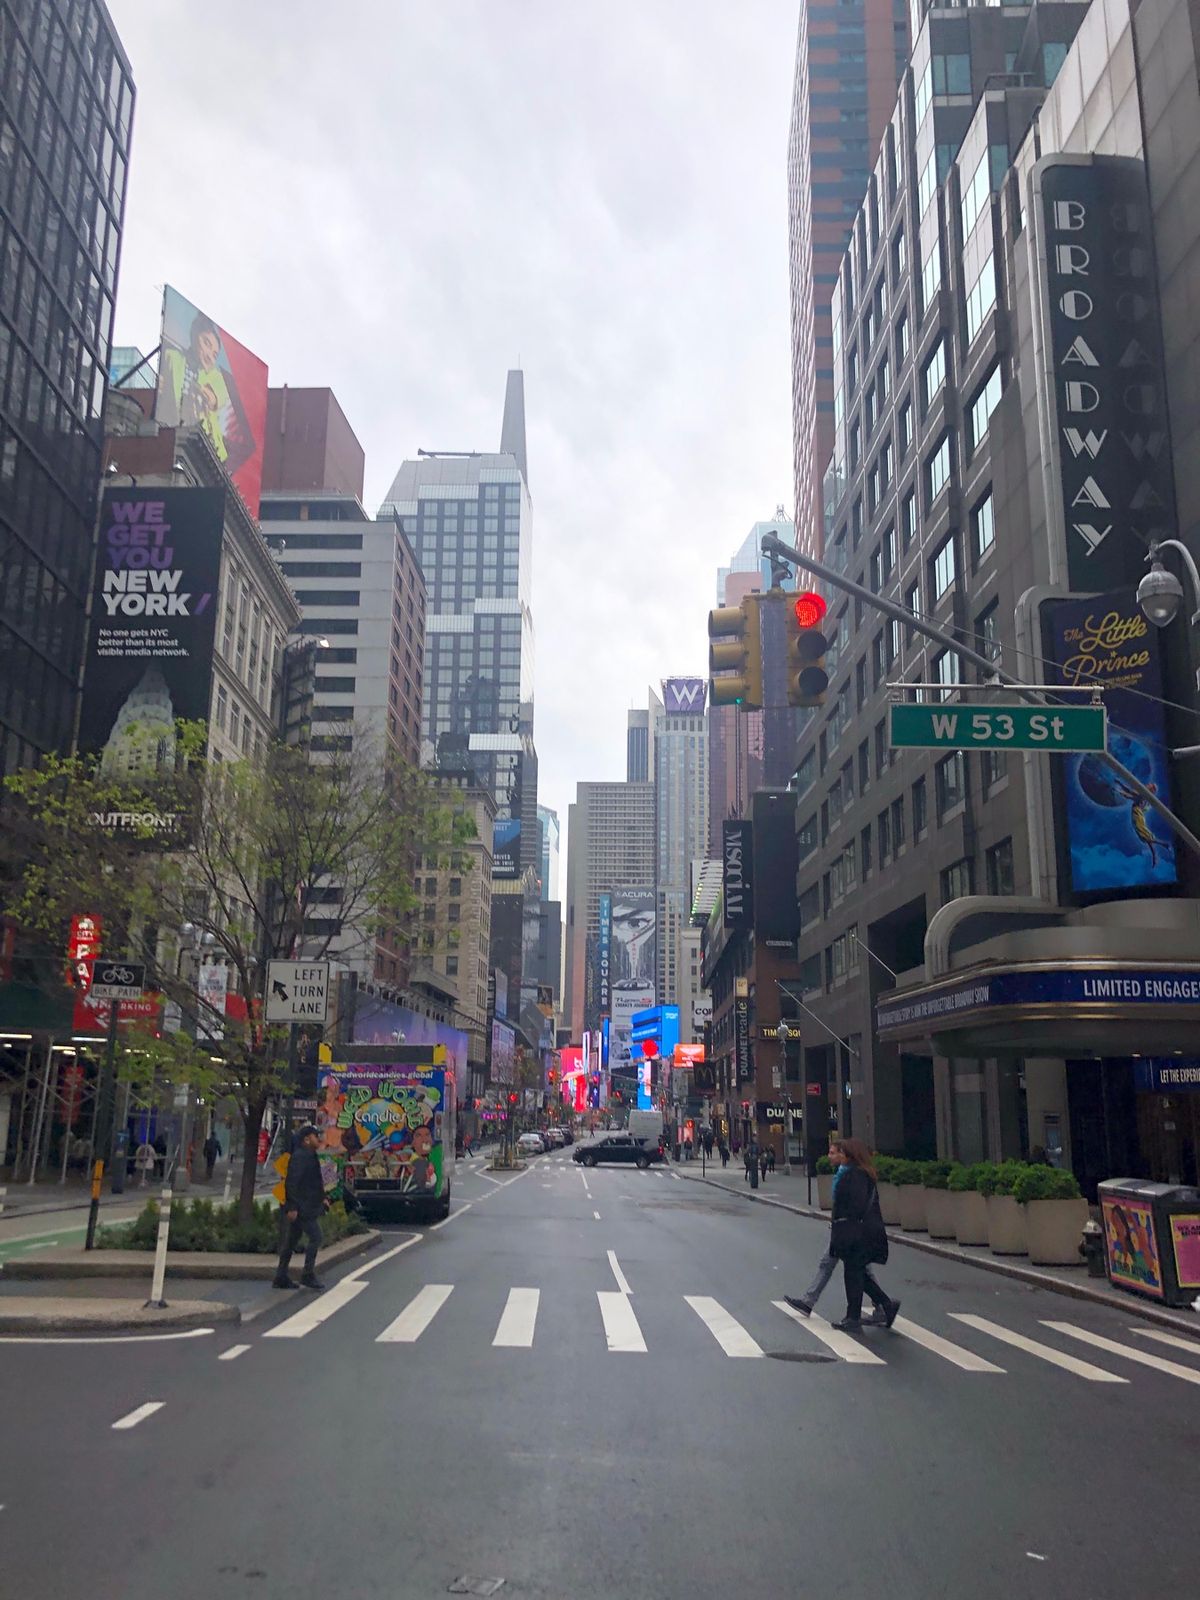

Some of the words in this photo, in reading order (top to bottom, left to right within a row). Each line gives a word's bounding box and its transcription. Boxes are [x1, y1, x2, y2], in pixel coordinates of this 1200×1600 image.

[1053, 200, 1112, 556] BROADWAY
[112, 502, 165, 523] WE
[107, 524, 171, 546] GET
[107, 547, 173, 569] YOU
[103, 570, 183, 592] NEW
[101, 593, 191, 616] YORK
[100, 629, 112, 637] No
[130, 629, 148, 638] gets
[150, 629, 169, 637] NYC
[1080, 612, 1147, 652] Little
[97, 648, 123, 656] visible
[125, 648, 151, 656] media
[152, 648, 189, 656] network.
[1062, 651, 1149, 686] Prince
[670, 684, 699, 705] W
[931, 714, 957, 739] W
[972, 715, 1015, 740] 53
[1029, 716, 1064, 740] St
[601, 900, 609, 944] TIMES
[294, 968, 323, 981] LEFT
[601, 950, 609, 1005] SQUARE
[94, 985, 112, 995] BIKE
[118, 986, 141, 997] PATH
[293, 985, 324, 997] TURN
[1083, 979, 1141, 997] LIMITED
[1145, 980, 1200, 998] ENGAGE
[291, 1002, 322, 1014] LANE
[1160, 1069, 1169, 1083] LET
[1170, 1069, 1180, 1082] THE
[355, 1109, 407, 1125] Candies
